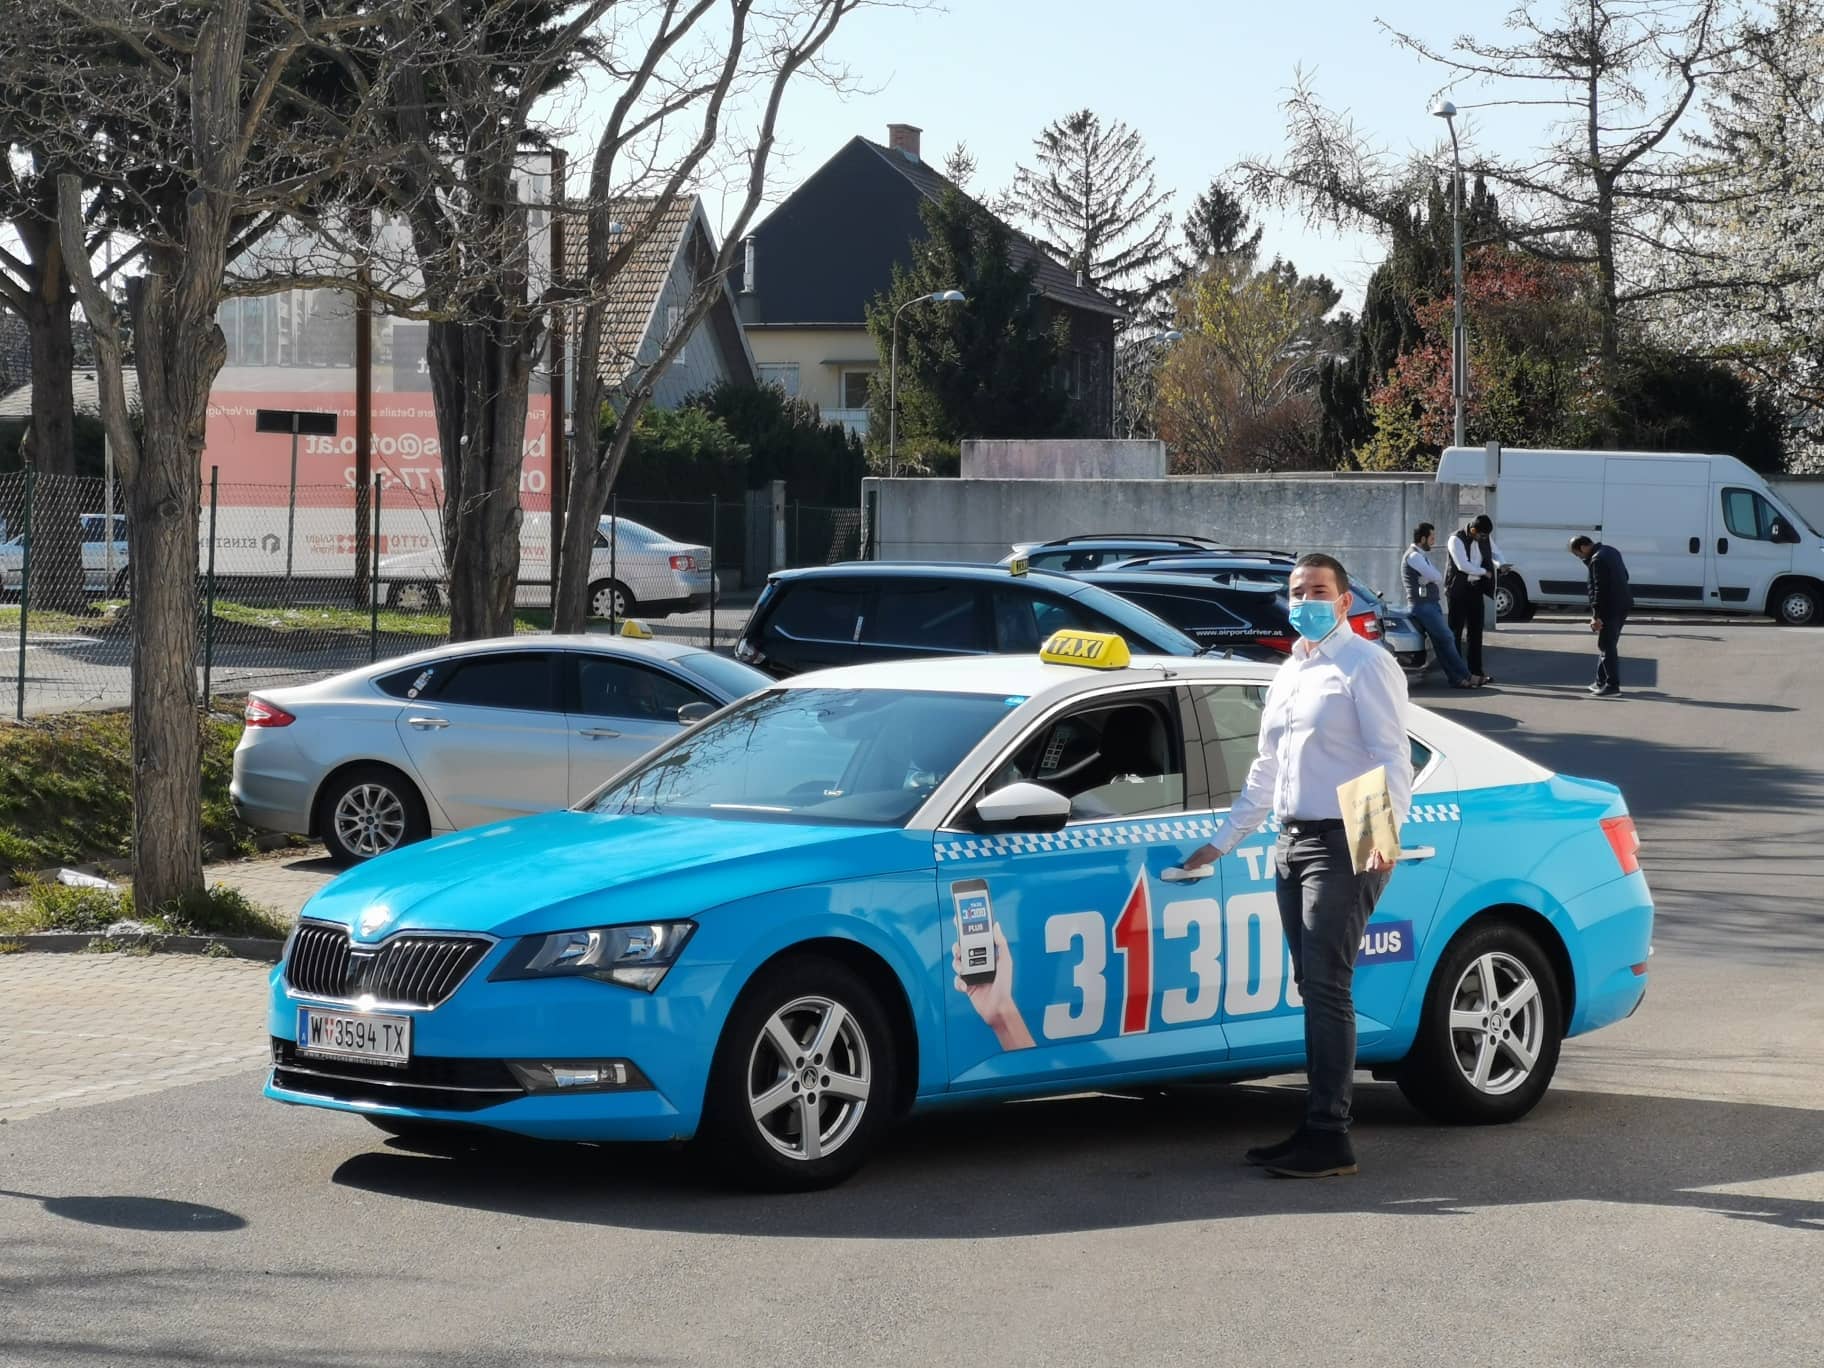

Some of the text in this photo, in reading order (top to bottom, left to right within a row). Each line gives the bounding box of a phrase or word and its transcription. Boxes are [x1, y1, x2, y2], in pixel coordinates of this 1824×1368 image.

[1195, 628, 1284, 638] www.airportdriver.at
[1049, 637, 1104, 659] TAXI
[311, 1015, 323, 1044] W
[335, 1018, 377, 1051] 3594
[382, 1024, 404, 1054] TX
